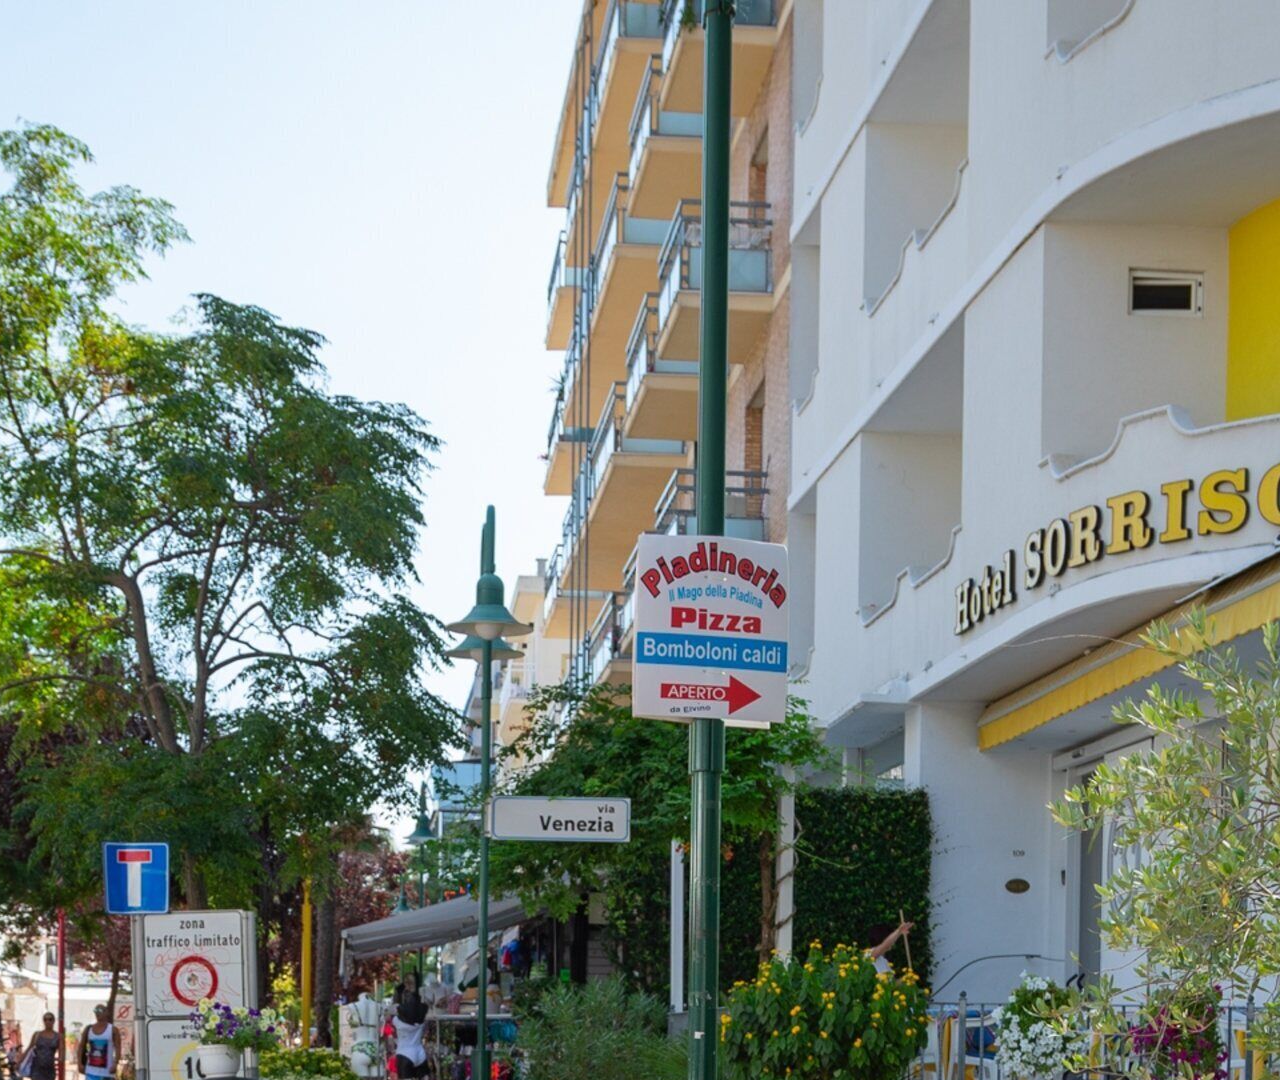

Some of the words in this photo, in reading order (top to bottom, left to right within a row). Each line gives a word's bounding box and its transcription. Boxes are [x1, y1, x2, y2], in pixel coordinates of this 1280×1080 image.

[640, 541, 787, 609] Piadineria
[677, 586, 702, 601] Mago
[705, 584, 727, 599] della
[730, 586, 763, 609] Piadina
[953, 547, 1018, 635] Hotel
[670, 606, 762, 634] Pizza
[643, 637, 738, 662] Bomboloni
[742, 644, 782, 665] caldi
[667, 684, 727, 700] APERTO
[597, 804, 616, 814] via
[539, 815, 615, 833] Venezia
[179, 919, 205, 930] zona
[146, 934, 190, 948] traffico
[194, 933, 240, 947] limitato
